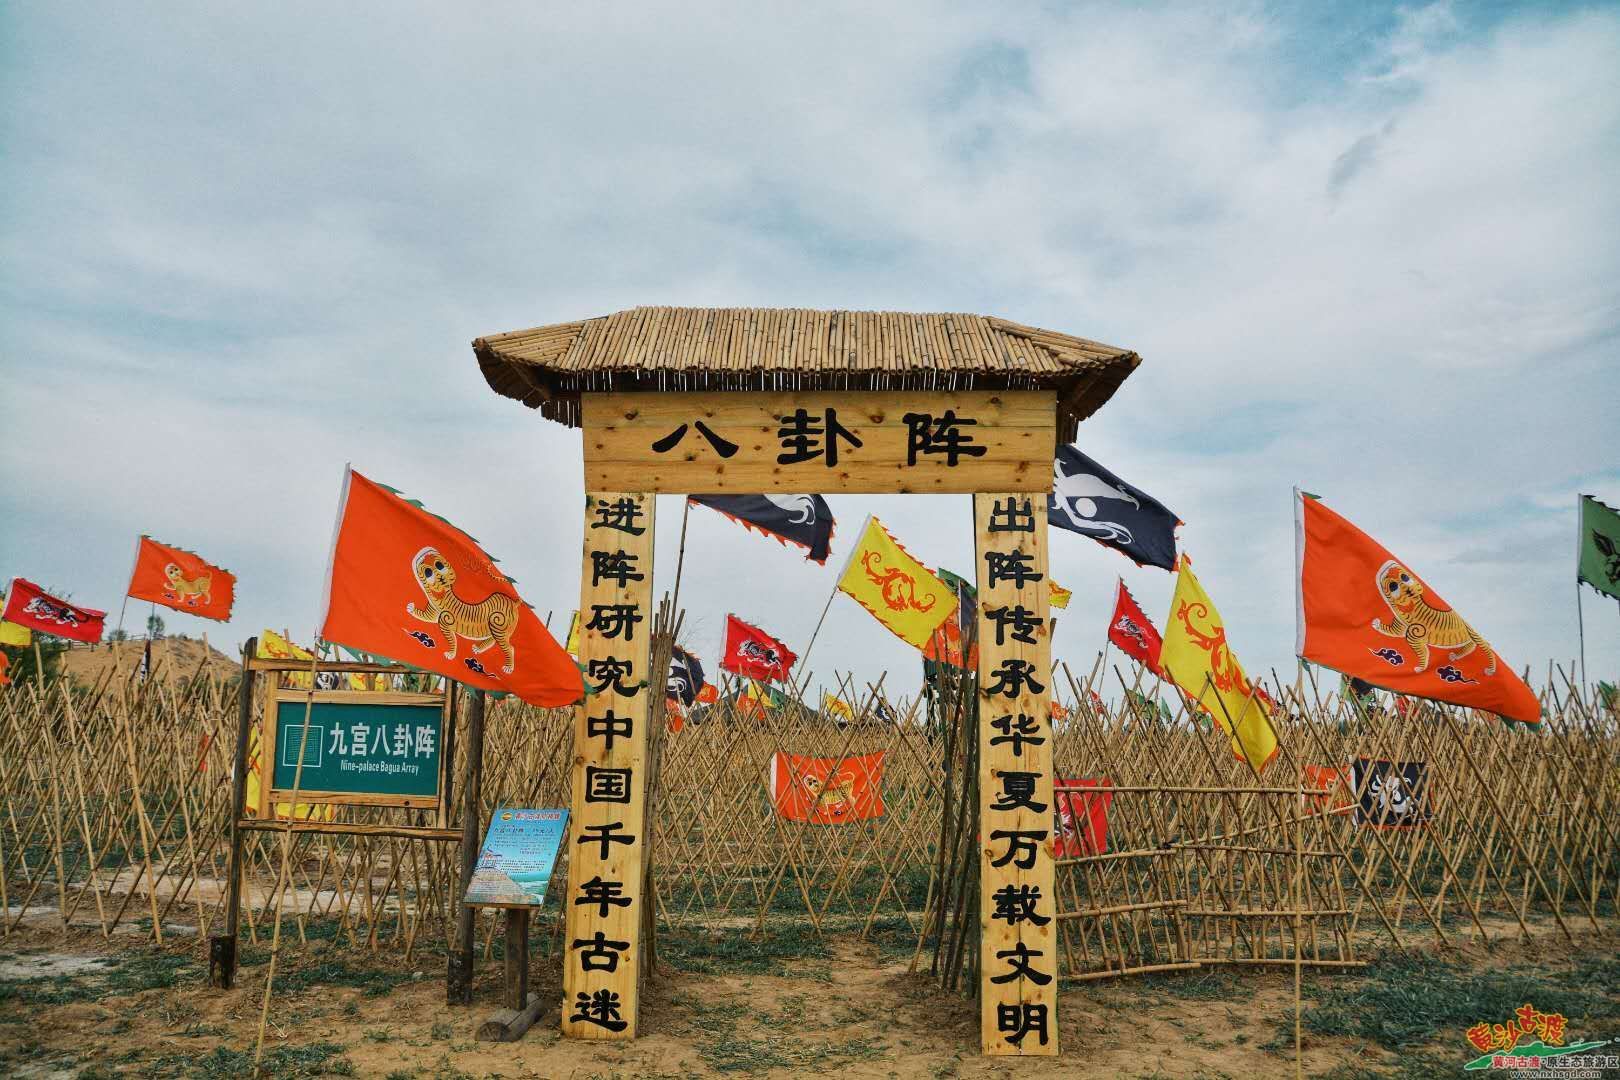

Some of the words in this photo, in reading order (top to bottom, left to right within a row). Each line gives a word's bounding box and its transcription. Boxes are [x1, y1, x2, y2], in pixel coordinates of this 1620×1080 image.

[652, 408, 987, 468] 八卦阵
[328, 721, 435, 759] 九宫八卦阵
[340, 760, 380, 774] Nine-palace
[381, 761, 401, 775] Bagua
[401, 763, 419, 775] Array
[569, 499, 645, 1033] 进阵研究中国千年古迷
[983, 496, 1053, 1046] 出阵传承华夏万载文明
